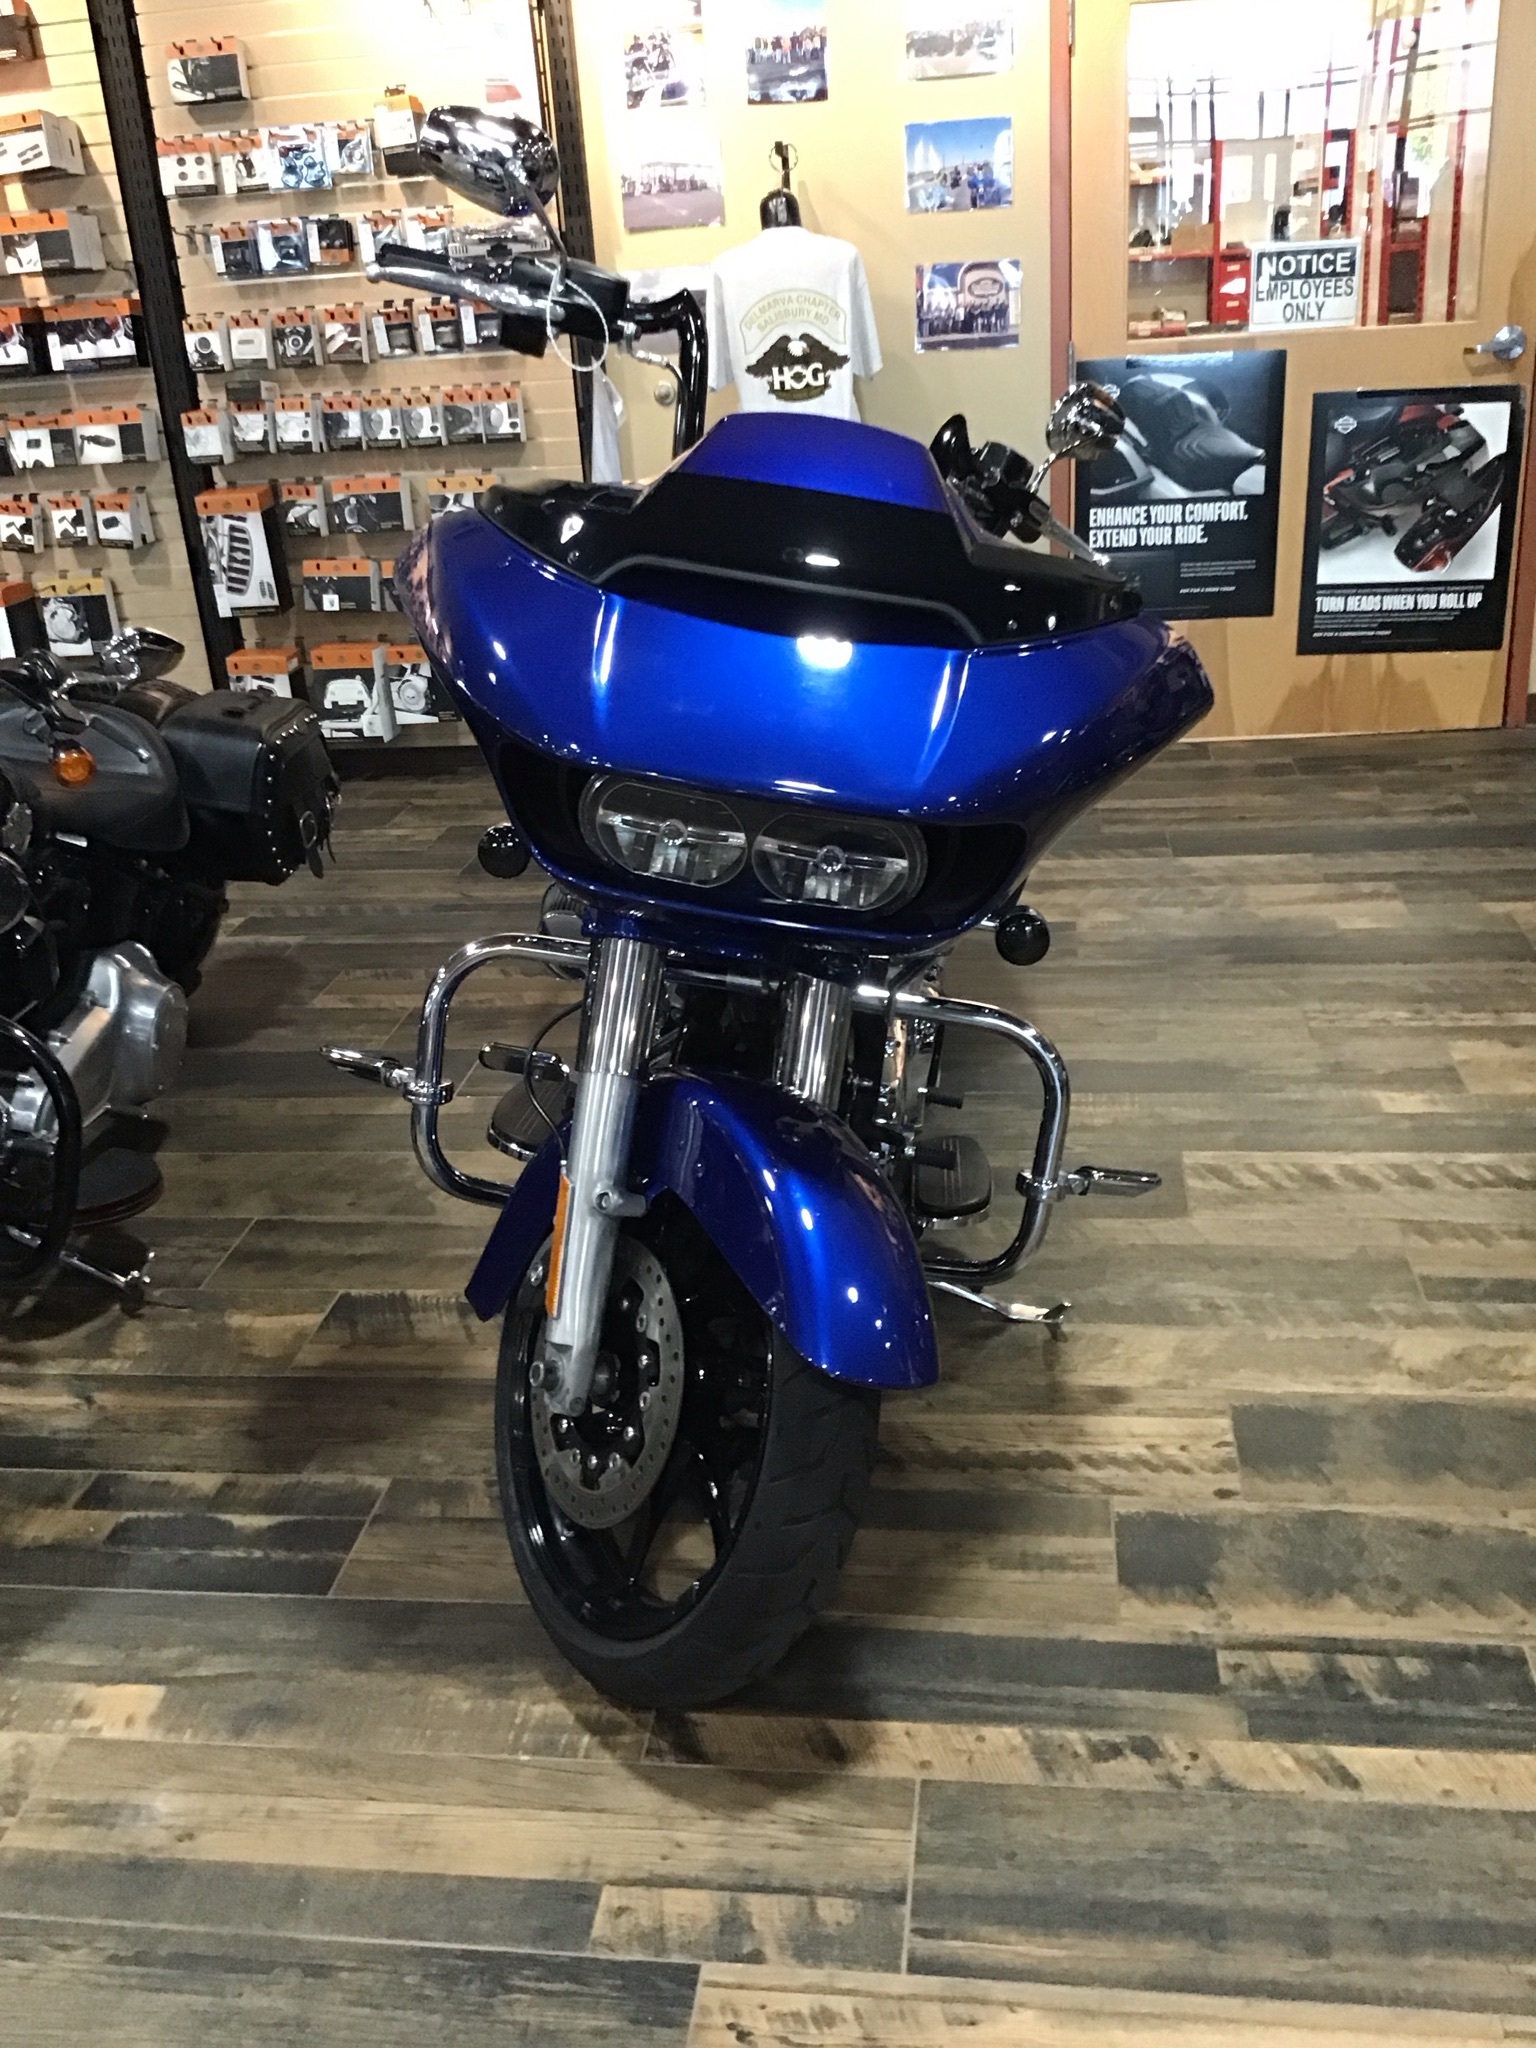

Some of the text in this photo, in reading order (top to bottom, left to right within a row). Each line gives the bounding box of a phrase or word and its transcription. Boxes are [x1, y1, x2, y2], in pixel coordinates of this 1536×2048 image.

[1261, 252, 1352, 276] NOTICE
[1256, 278, 1354, 302] EMPLOYEES
[744, 294, 841, 331] DELMARVA CHAPTER
[757, 307, 830, 332] SALISBURY MD
[1282, 301, 1325, 323] ONLY
[1089, 501, 1249, 528] ENHANCE YOUR COMFORT.
[1089, 524, 1209, 549] EXTEND YOUR RIDE.
[1314, 591, 1483, 613] TURN HEADS WHEN YOU ROLL UP
